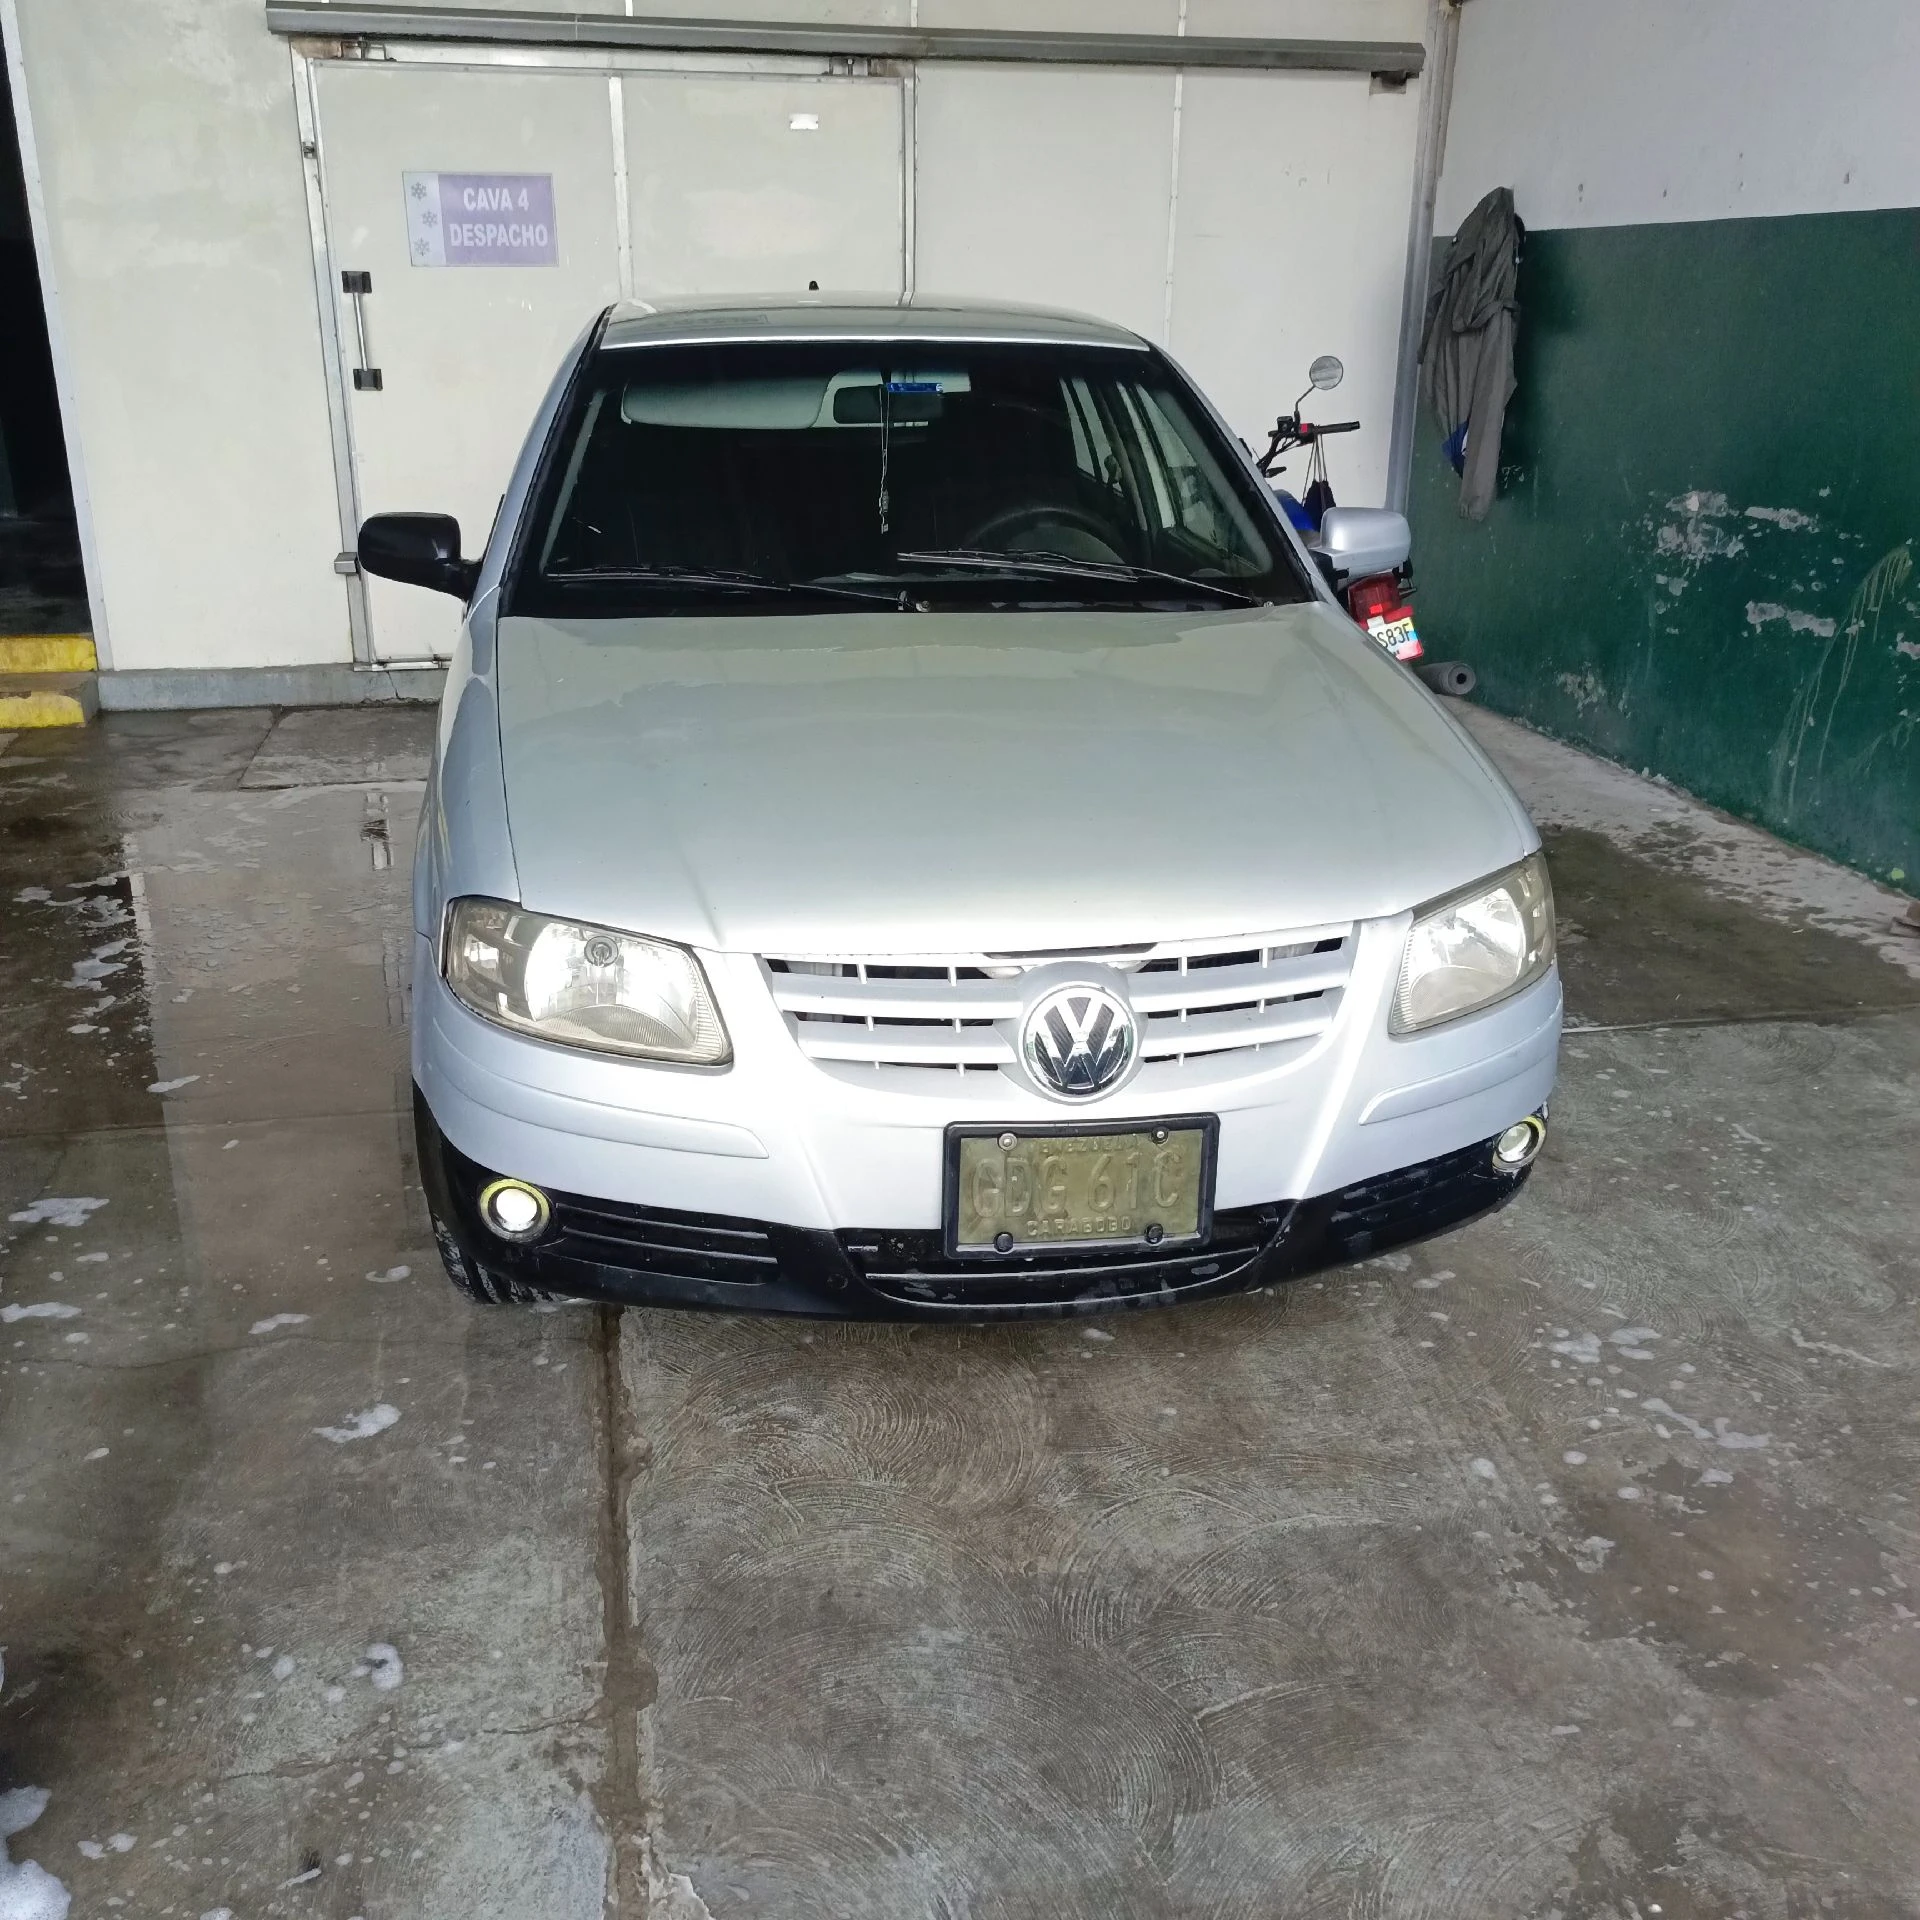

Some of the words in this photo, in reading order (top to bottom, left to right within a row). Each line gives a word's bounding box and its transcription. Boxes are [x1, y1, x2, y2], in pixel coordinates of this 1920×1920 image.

[463, 187, 512, 211] CAVA
[518, 187, 530, 211] 4
[450, 223, 548, 247] DESPACHO
[1026, 986, 1133, 1095] VW
[1026, 1216, 1131, 1236] CARABOBO
